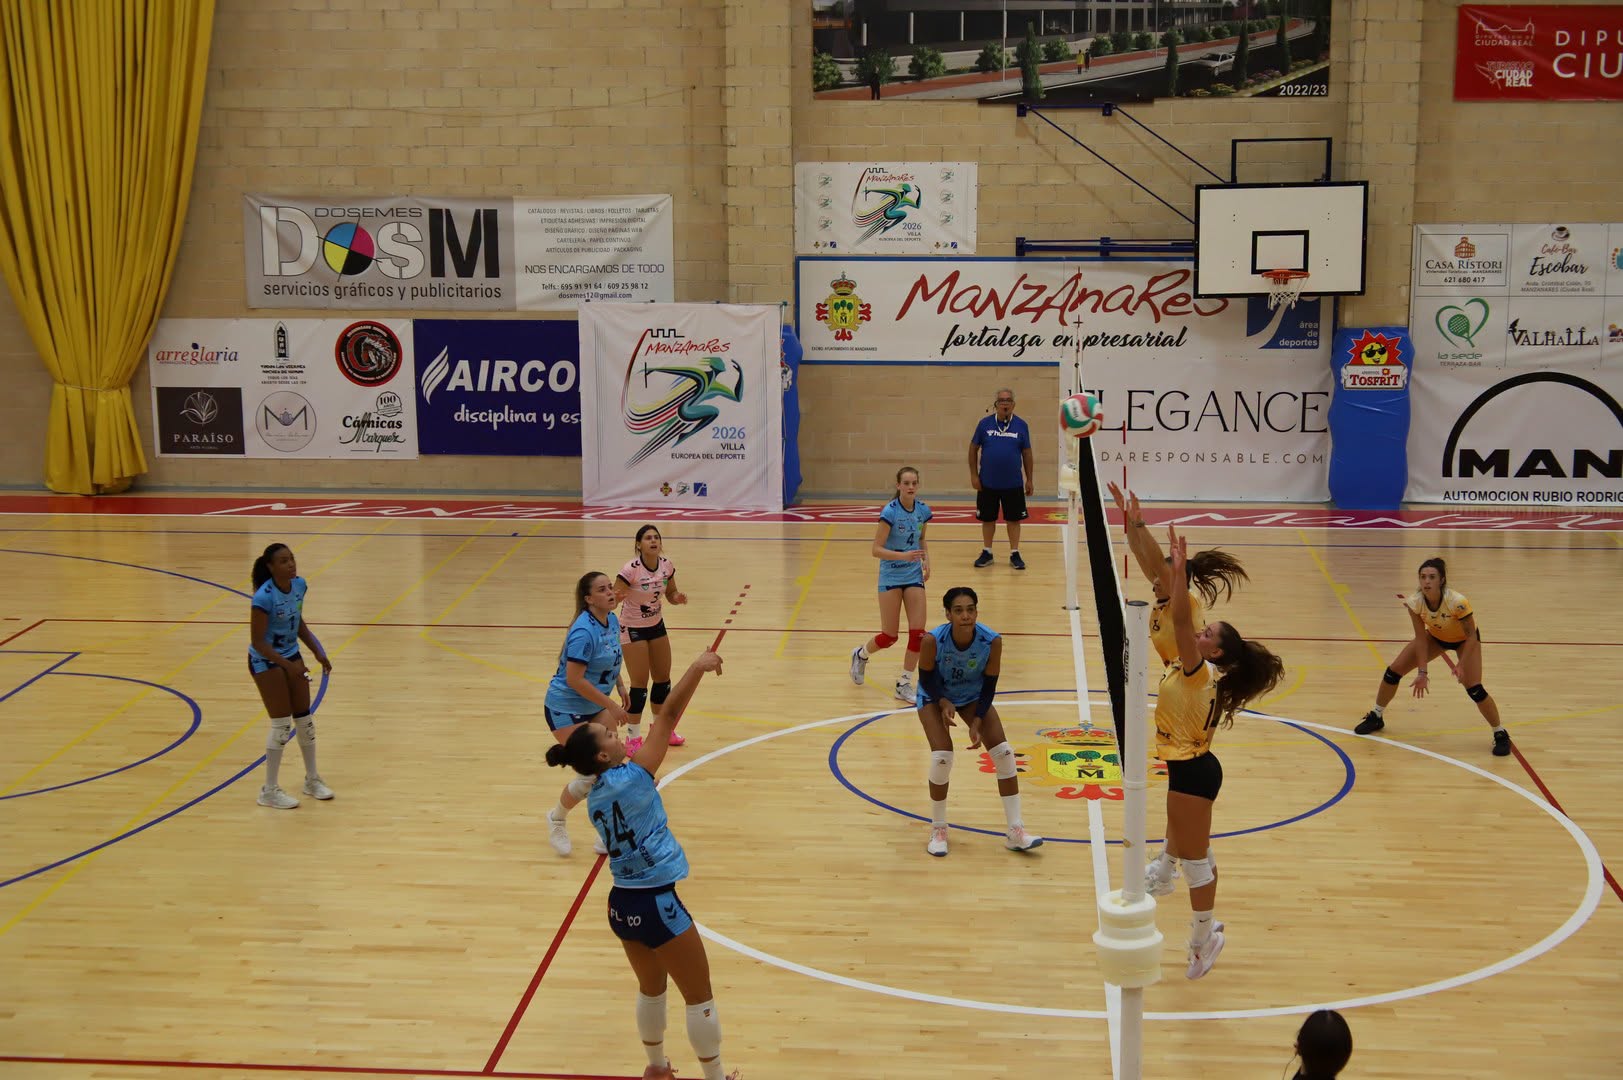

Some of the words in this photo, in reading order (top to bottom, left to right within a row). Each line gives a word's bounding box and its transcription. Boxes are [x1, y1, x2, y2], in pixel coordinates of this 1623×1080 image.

[1552, 52, 1623, 79] CIU
[1495, 69, 1533, 79] CIUDAD
[1505, 78, 1533, 87] REAL
[1279, 84, 1328, 96] 2022/23
[314, 207, 423, 218] DOSEMES
[902, 222, 922, 231] 2026
[524, 264, 547, 274] NOS
[548, 264, 620, 274] ENCARGAMOS
[621, 264, 635, 274] DE
[638, 264, 665, 274] TODO
[1425, 259, 1454, 270] CASA
[1529, 253, 1589, 276] Escobar
[263, 282, 330, 297] servicios
[334, 282, 394, 300] gráficos
[398, 285, 406, 300] y
[411, 282, 502, 300] publicitarios
[560, 282, 573, 290] 695
[574, 282, 582, 290] 91
[584, 282, 592, 290] 91
[594, 282, 602, 290] 64
[607, 282, 620, 290] 609
[621, 282, 630, 290] 25
[630, 282, 639, 290] 98
[641, 282, 648, 290] 12
[558, 291, 632, 299] dosemes12@gmail.com
[1299, 321, 1319, 329] área
[1307, 329, 1319, 338] de
[940, 324, 1045, 357] fortaleza
[1279, 337, 1318, 347] deportes
[156, 346, 239, 366] arreglaria
[1437, 351, 1449, 360] la
[1452, 351, 1483, 360] sede
[446, 359, 581, 393] AIRCO
[1349, 374, 1401, 386] TOSFRIT
[380, 395, 397, 405] 100
[454, 403, 537, 431] disciplina
[543, 412, 556, 430] y
[561, 412, 582, 424] es
[1068, 389, 1329, 433] LEGANCE
[342, 415, 403, 429] Cárnicas
[173, 432, 234, 443] PARAÍSO
[712, 426, 746, 440] 2026
[720, 442, 746, 451] VILLA
[671, 452, 701, 460] EUROPEA
[702, 452, 714, 460] DEL
[716, 452, 746, 460] DEPORTE
[1458, 448, 1623, 479] MAN
[1442, 490, 1529, 501] AUTOMOCION
[1532, 491, 1573, 502] RUBIO
[906, 532, 915, 546] 4
[650, 591, 660, 604] 3
[593, 799, 638, 859] 24
